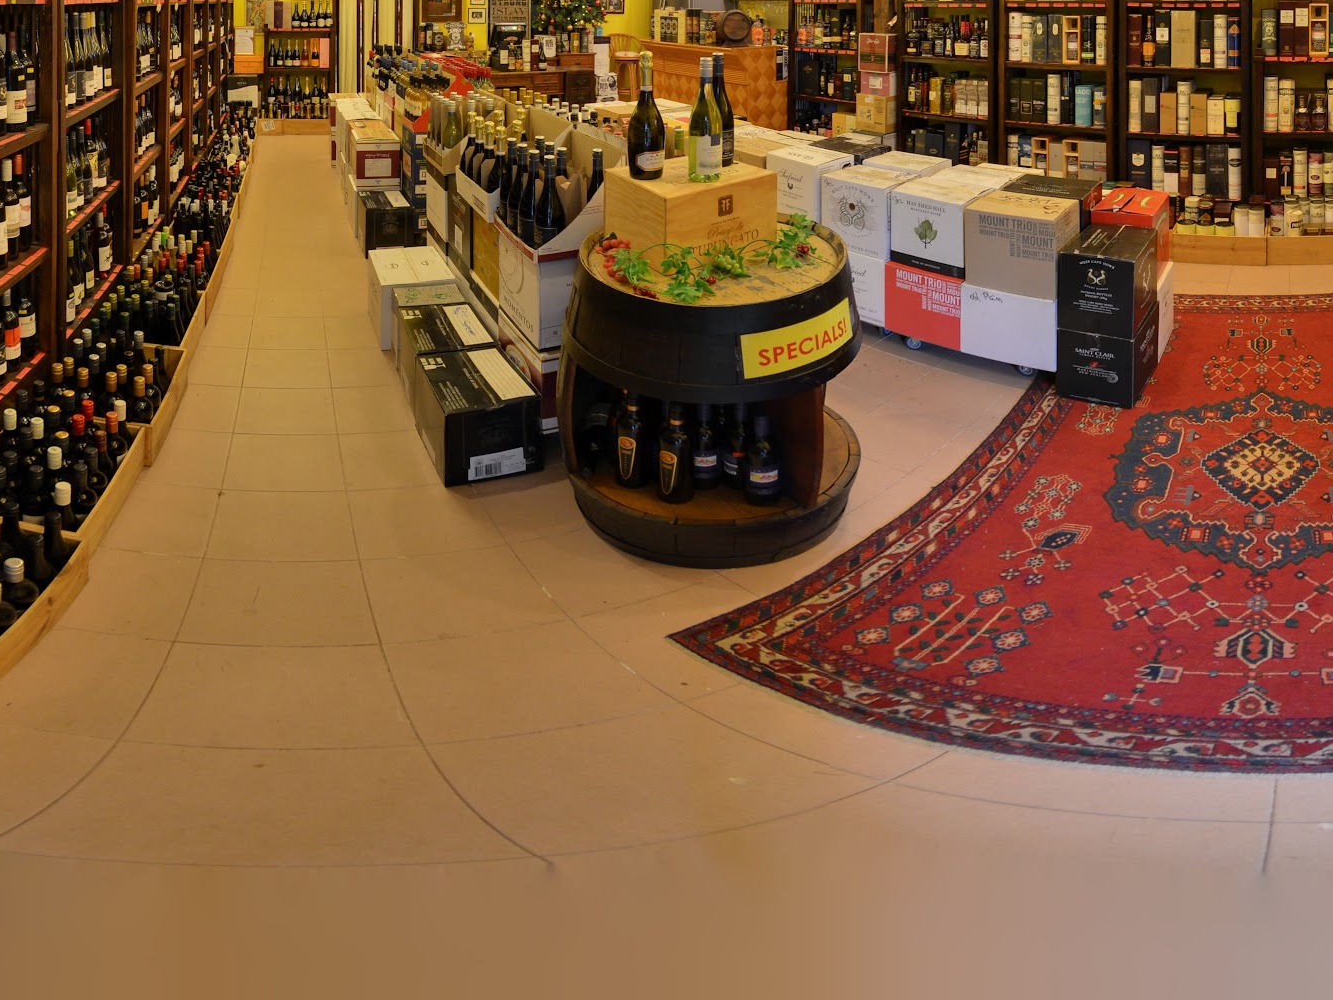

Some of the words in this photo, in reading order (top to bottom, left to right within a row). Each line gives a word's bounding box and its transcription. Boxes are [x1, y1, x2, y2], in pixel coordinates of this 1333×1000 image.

[906, 199, 917, 207] HAY
[917, 201, 932, 210] SHED
[932, 205, 946, 214] HILL
[978, 214, 1010, 229] MOUNT
[979, 228, 997, 238] MOUNT
[1021, 235, 1054, 249] MOUNT
[896, 269, 923, 284] MOUNT
[933, 291, 961, 306] MOUNT
[758, 317, 847, 367] SPECIALS!
[1075, 347, 1094, 356] SAINT
[1095, 350, 1115, 359] CLAIR
